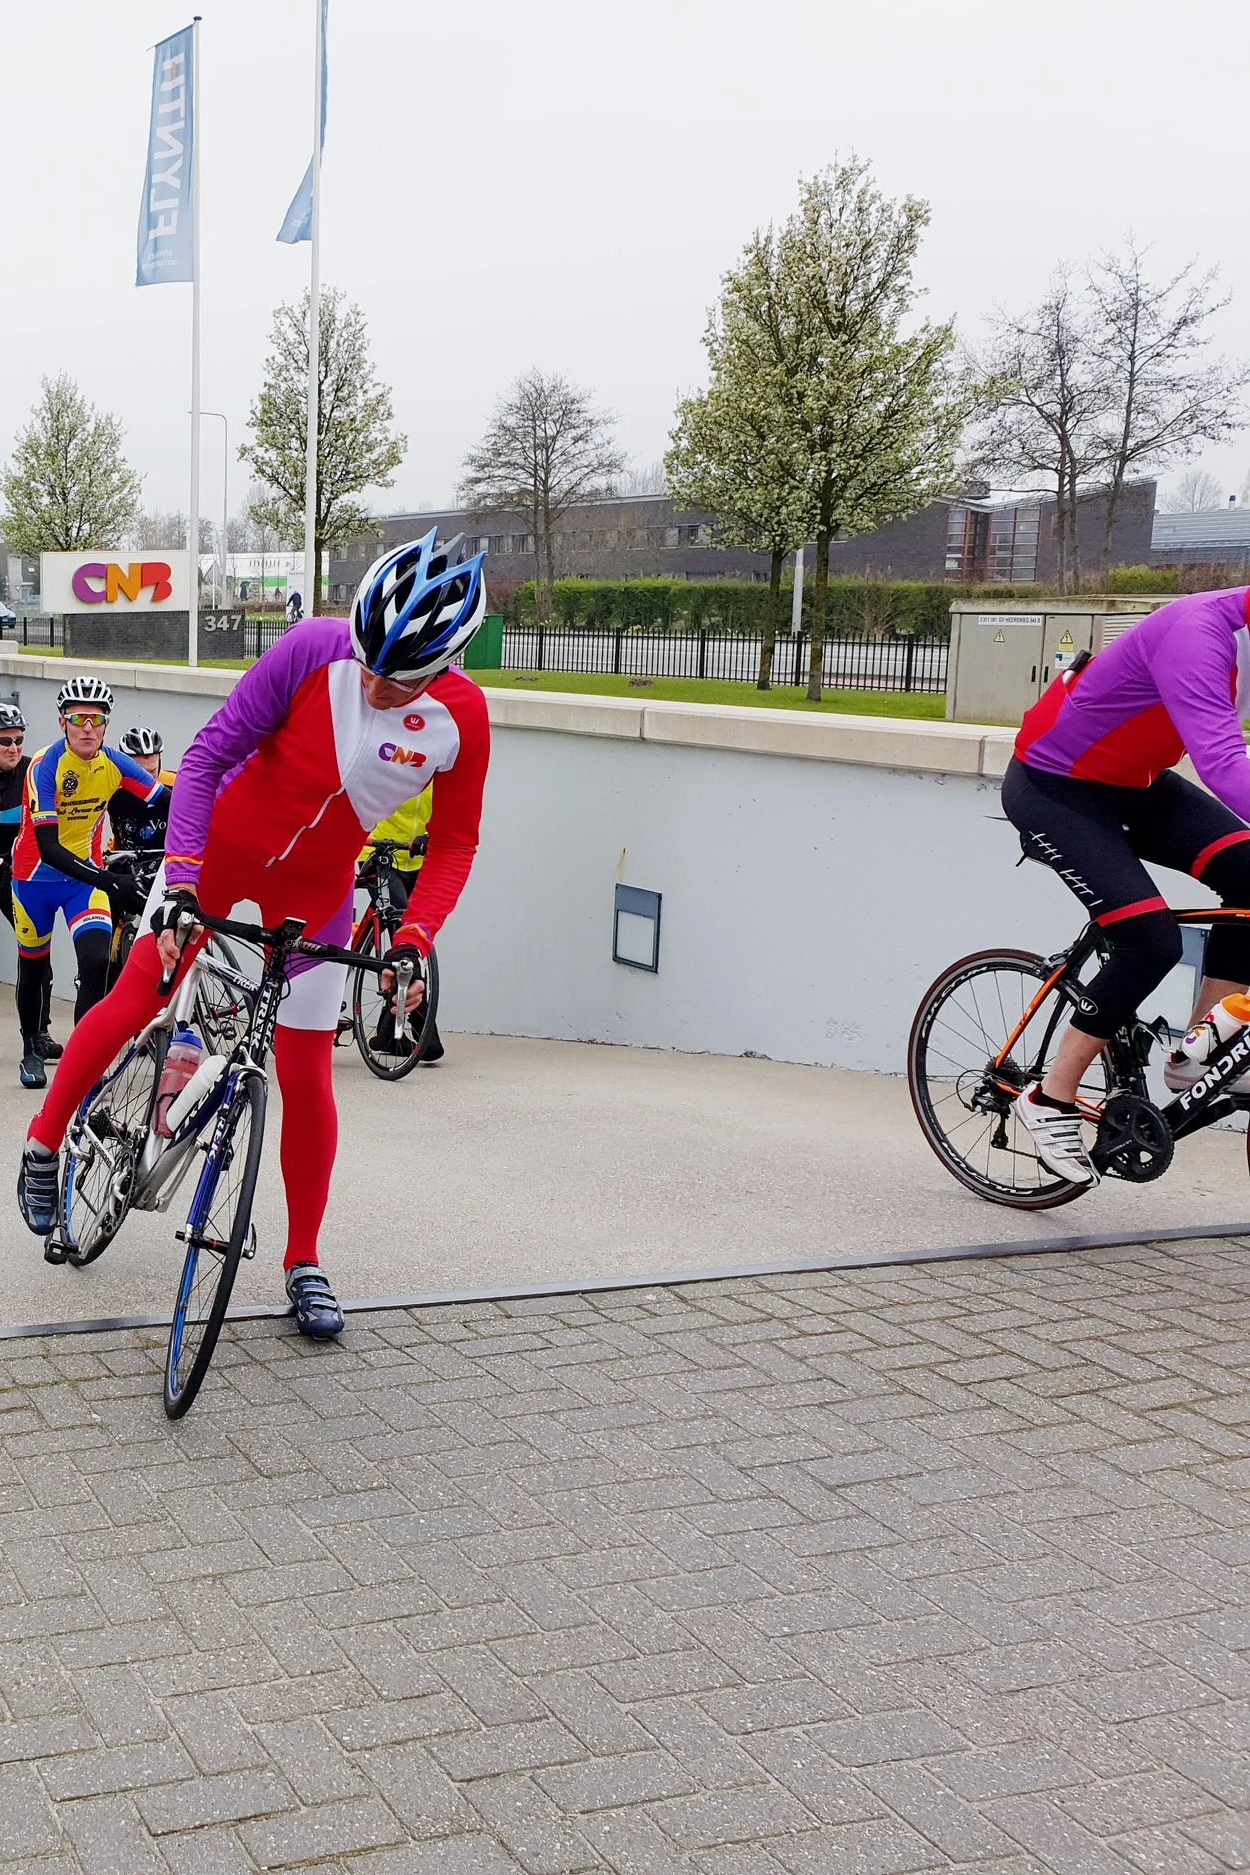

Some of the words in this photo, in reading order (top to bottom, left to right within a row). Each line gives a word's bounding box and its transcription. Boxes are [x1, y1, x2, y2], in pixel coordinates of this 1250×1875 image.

[71, 561, 173, 604] CNB
[204, 614, 242, 632] 347
[378, 742, 427, 768] CNB
